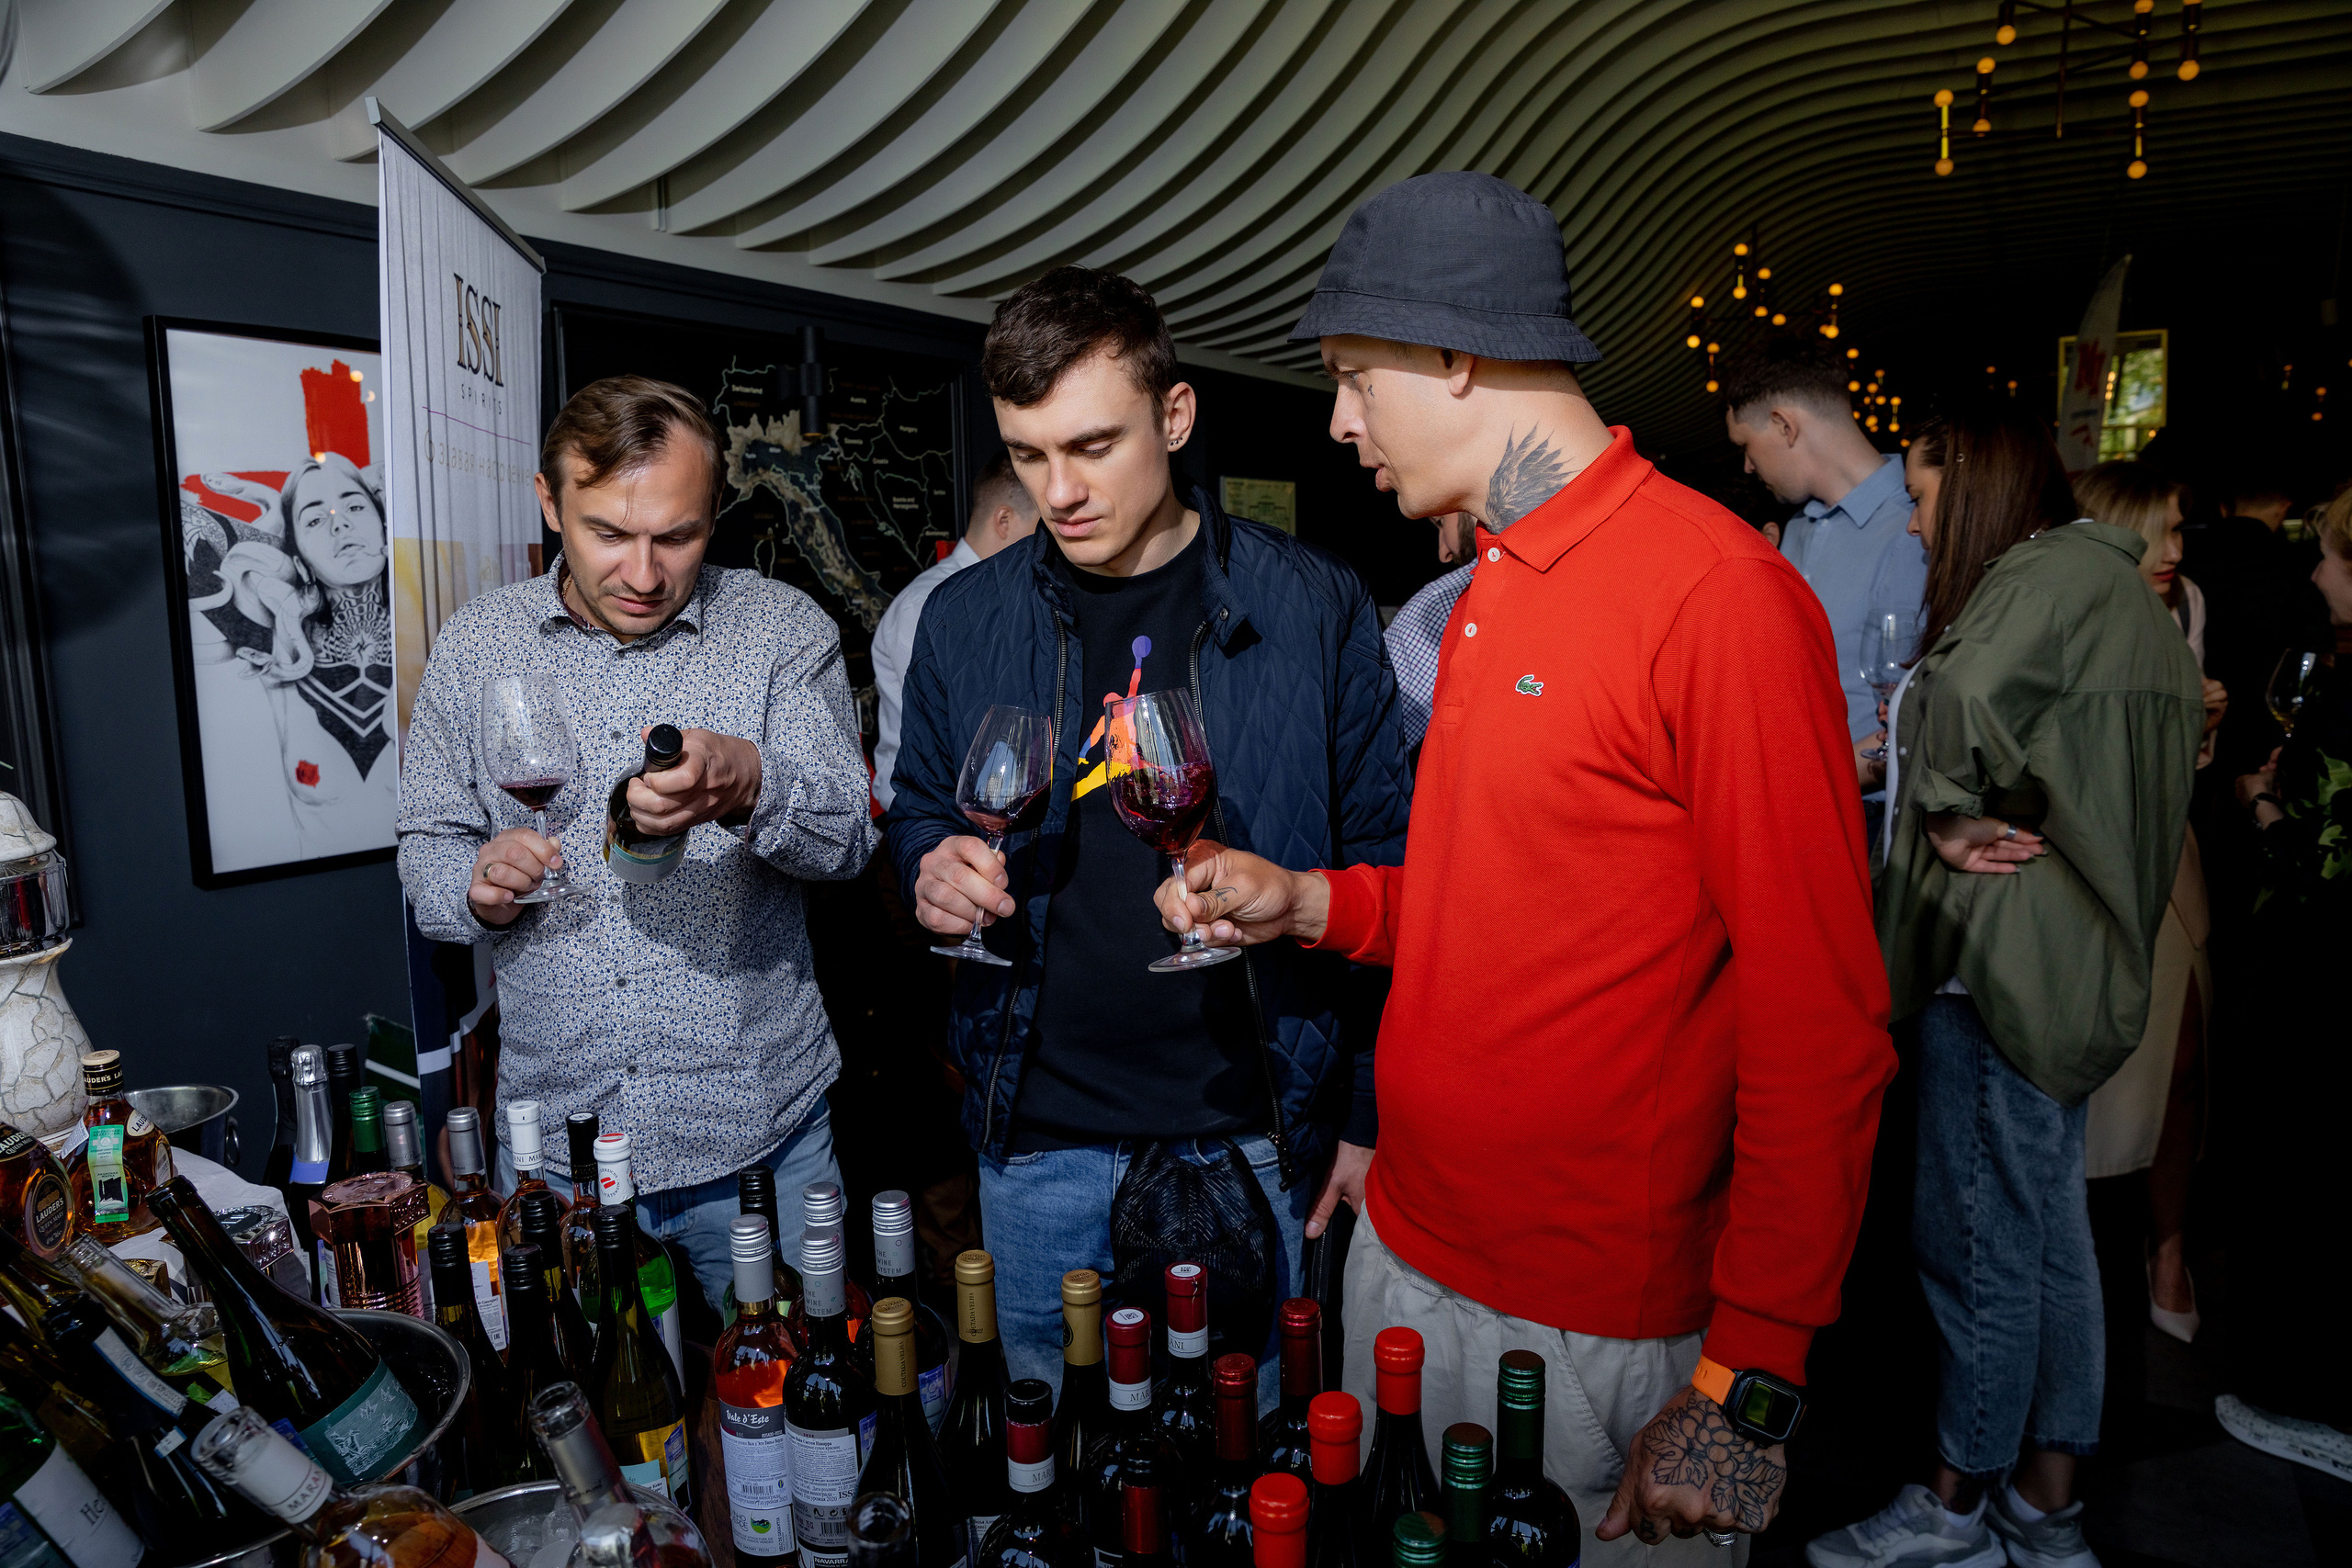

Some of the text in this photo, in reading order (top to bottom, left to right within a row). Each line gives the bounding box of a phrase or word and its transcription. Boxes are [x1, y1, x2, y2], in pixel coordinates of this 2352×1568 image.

[454, 273, 503, 387] ISSI
[461, 383, 502, 415] SPIRITS
[514, 1154, 525, 1163] ANI
[36, 1197, 64, 1224] LAUDER'S
[39, 1211, 64, 1234] QUEEN MARY
[876, 1248, 886, 1258] THE
[877, 1258, 891, 1267] WINE
[877, 1265, 901, 1274] SYSTEM
[805, 1289, 816, 1297] THE
[806, 1305, 832, 1314] SYSTEM
[1170, 1338, 1184, 1349] ANI
[726, 1409, 770, 1425] Vale d'Este
